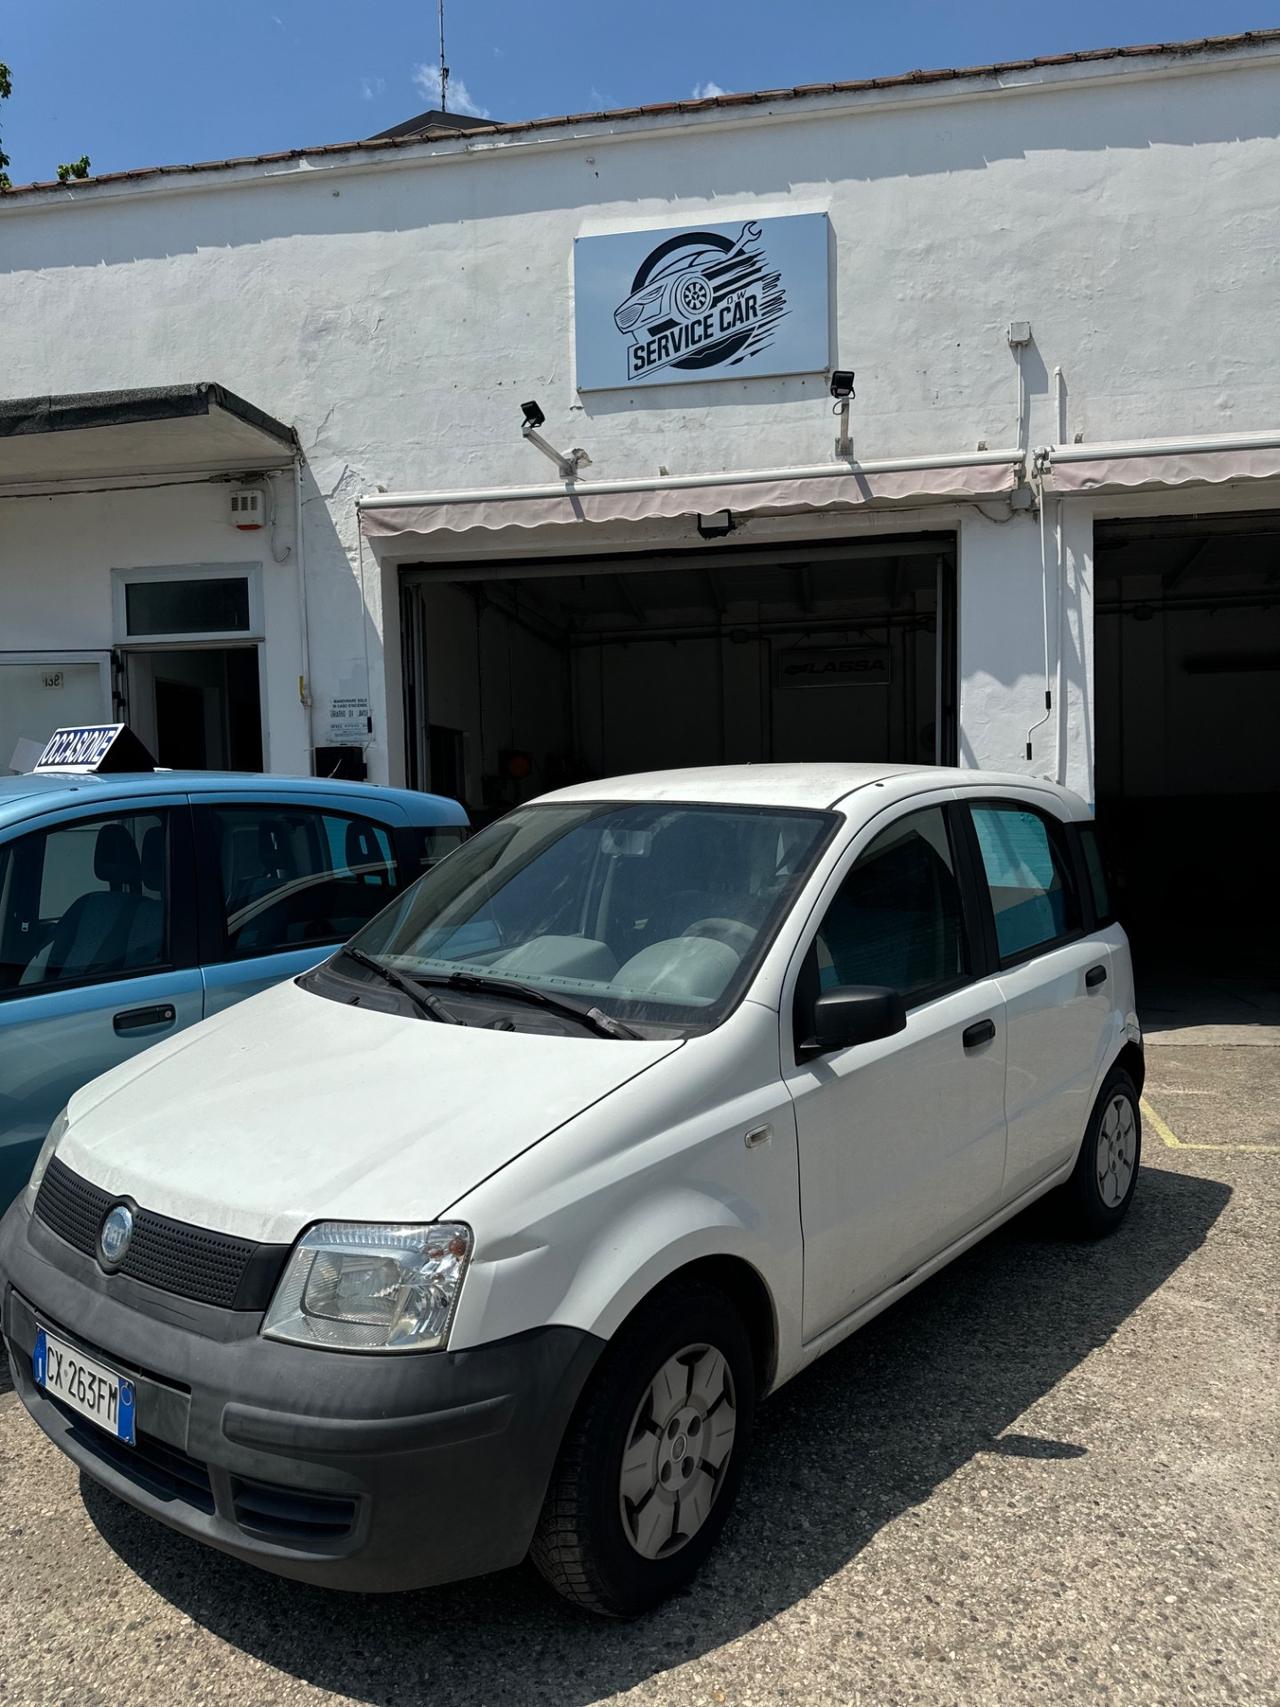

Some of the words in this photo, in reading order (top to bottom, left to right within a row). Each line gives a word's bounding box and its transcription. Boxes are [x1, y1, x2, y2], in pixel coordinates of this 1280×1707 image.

[633, 314, 714, 371] SERVICE
[719, 294, 758, 333] CAR
[41, 730, 116, 764] OCCASIONE
